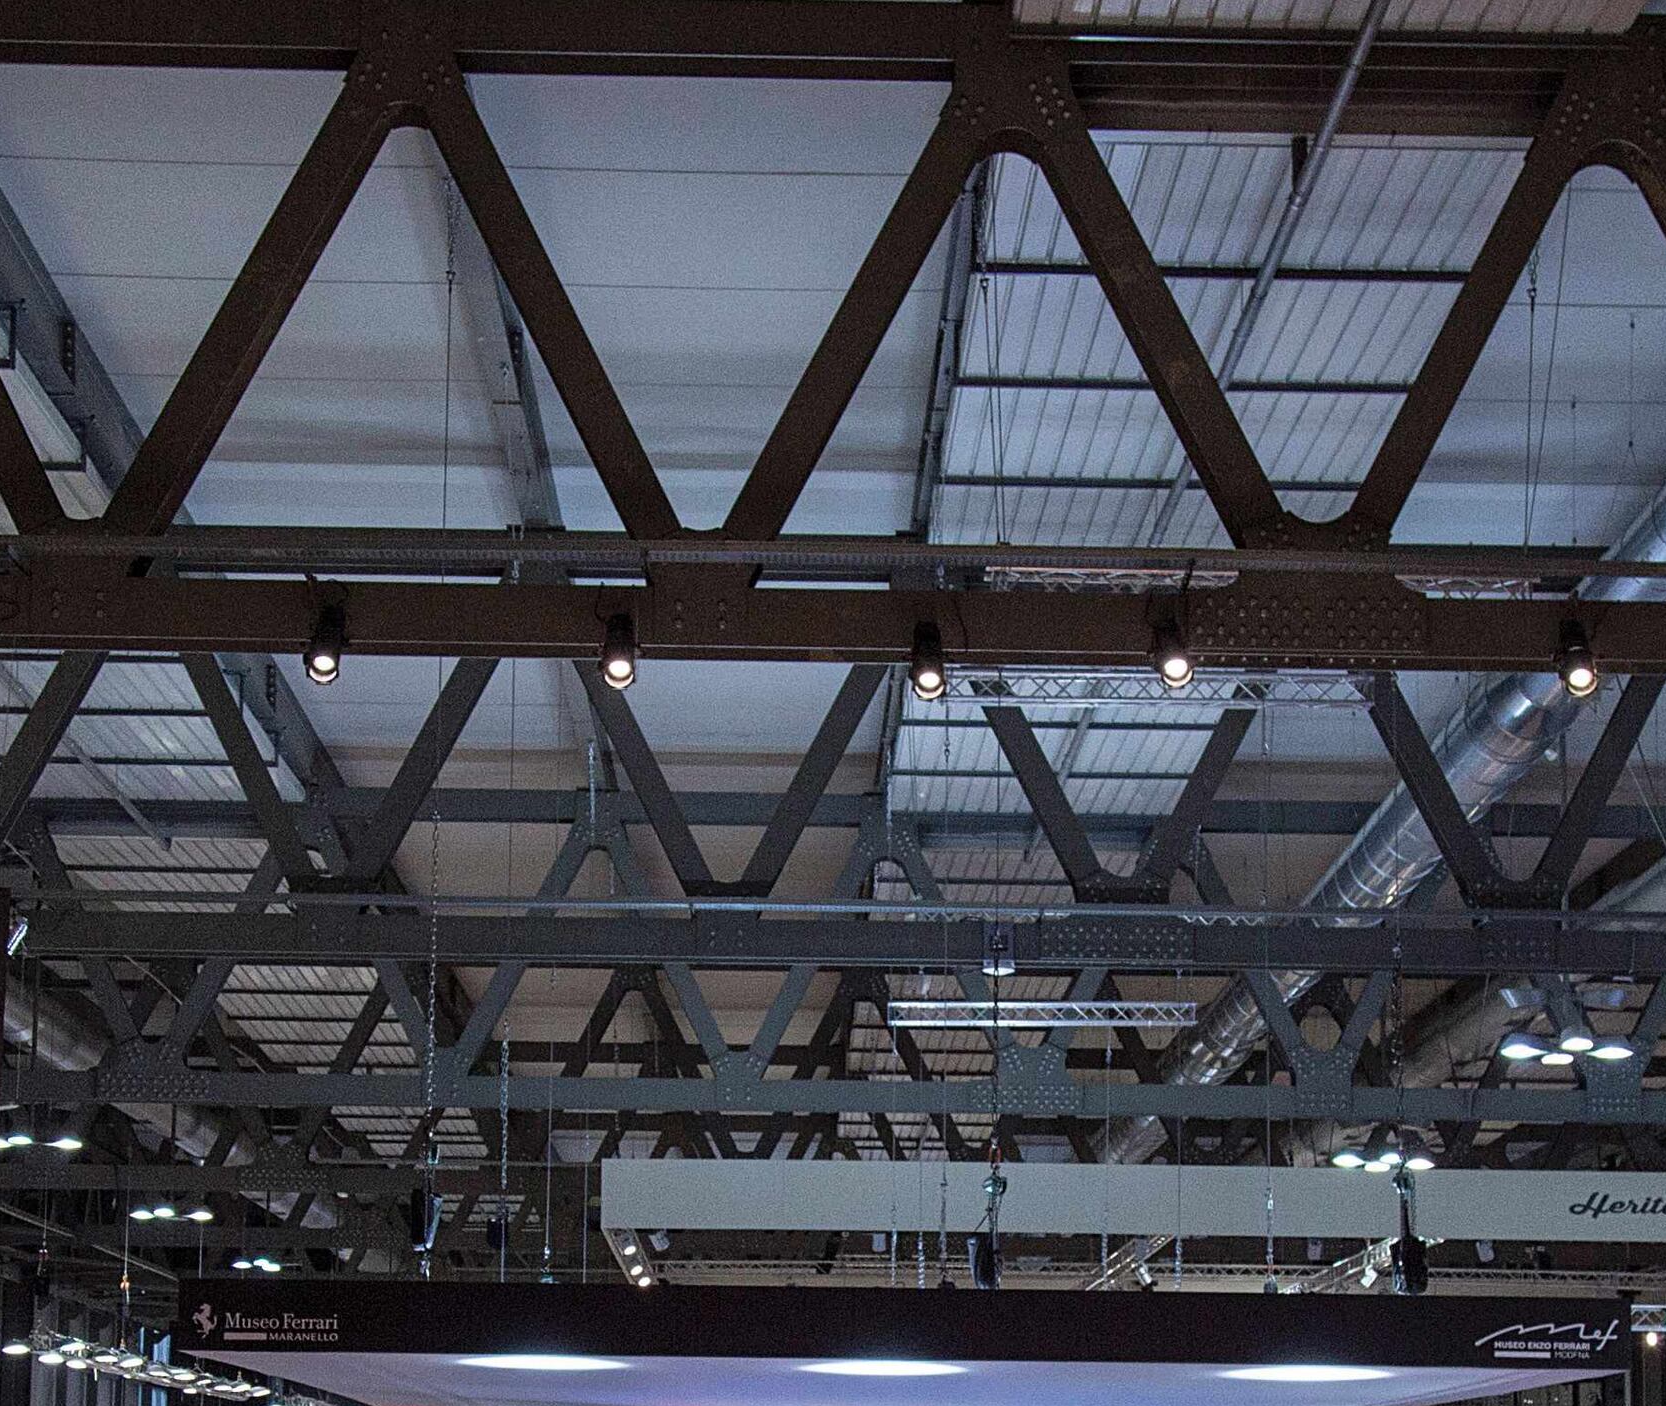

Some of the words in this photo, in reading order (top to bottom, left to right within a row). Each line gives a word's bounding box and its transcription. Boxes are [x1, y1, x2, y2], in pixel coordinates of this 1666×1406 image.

[224, 1312, 279, 1329] Museo
[282, 1313, 338, 1330] Ferrari
[268, 1332, 338, 1341] MARANELLO
[1493, 1341, 1525, 1349] MUSEO
[1527, 1341, 1551, 1350] ENZO
[1553, 1342, 1590, 1351] FERRARI
